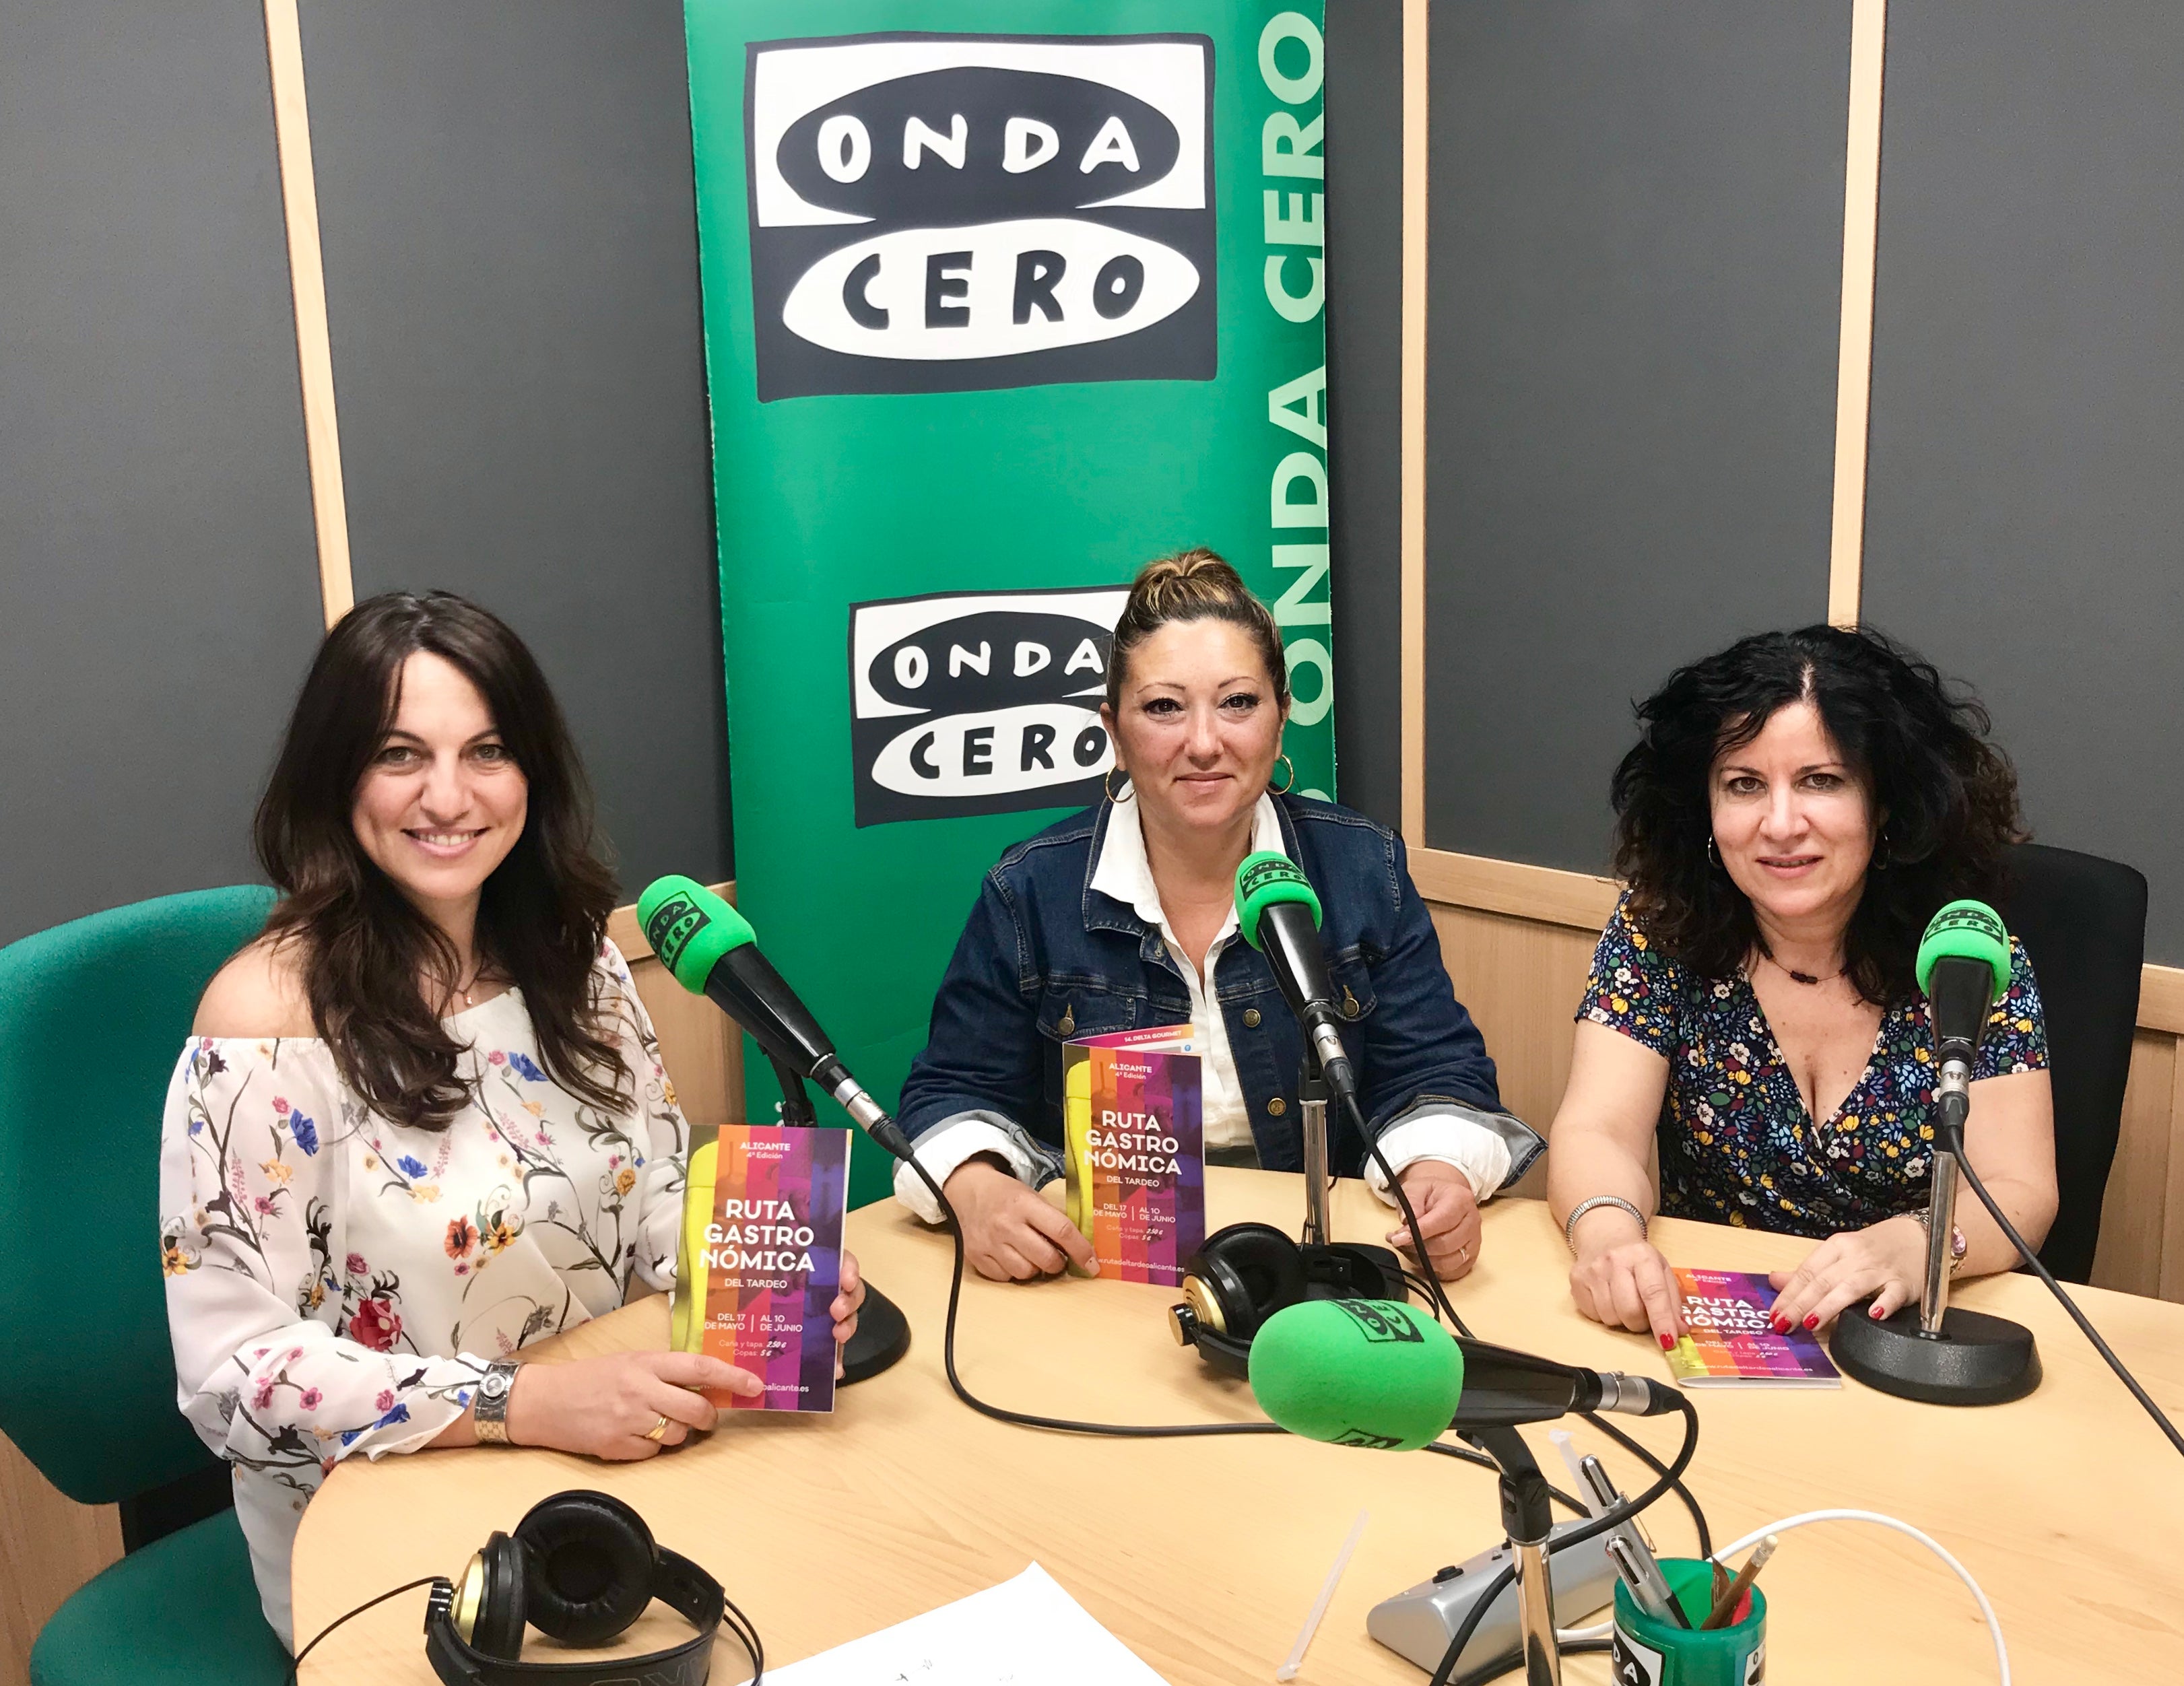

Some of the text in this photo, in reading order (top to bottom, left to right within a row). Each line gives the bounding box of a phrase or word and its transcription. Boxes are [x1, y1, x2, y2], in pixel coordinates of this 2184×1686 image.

[816, 113, 1140, 184] ONDA
[1257, 11, 1325, 324] CERO
[842, 250, 1146, 330] CERO
[1267, 365, 1333, 727] ONDA
[895, 638, 1104, 681] ONDA
[909, 724, 1115, 776] CERO
[1252, 871, 1302, 885] CERO
[1934, 920, 1993, 932] CERO
[662, 916, 694, 963] CERO
[1152, 1030, 1182, 1039] GOURMET
[1108, 1063, 1152, 1073] ALICANTE
[1102, 1110, 1162, 1132] RUTA
[739, 1141, 791, 1151] ALICANTE
[1085, 1130, 1179, 1153] GASTRO
[756, 1151, 783, 1159] Edición
[1084, 1148, 1182, 1175] NÓMICA
[1106, 1175, 1160, 1187] DEL TARDEO
[725, 1199, 795, 1221] RUTA
[1104, 1211, 1127, 1219] MAYO
[1151, 1215, 1176, 1223] JUNIO
[704, 1224, 814, 1247] GASTRO
[699, 1244, 816, 1272] NÓMICA
[725, 1278, 787, 1289] DEL TARDEO
[1686, 1296, 1753, 1309] RUTA
[717, 1313, 735, 1321] DEL
[760, 1314, 772, 1322] AL
[704, 1321, 746, 1330] DE MAYO
[760, 1323, 803, 1332] DE JUNIO
